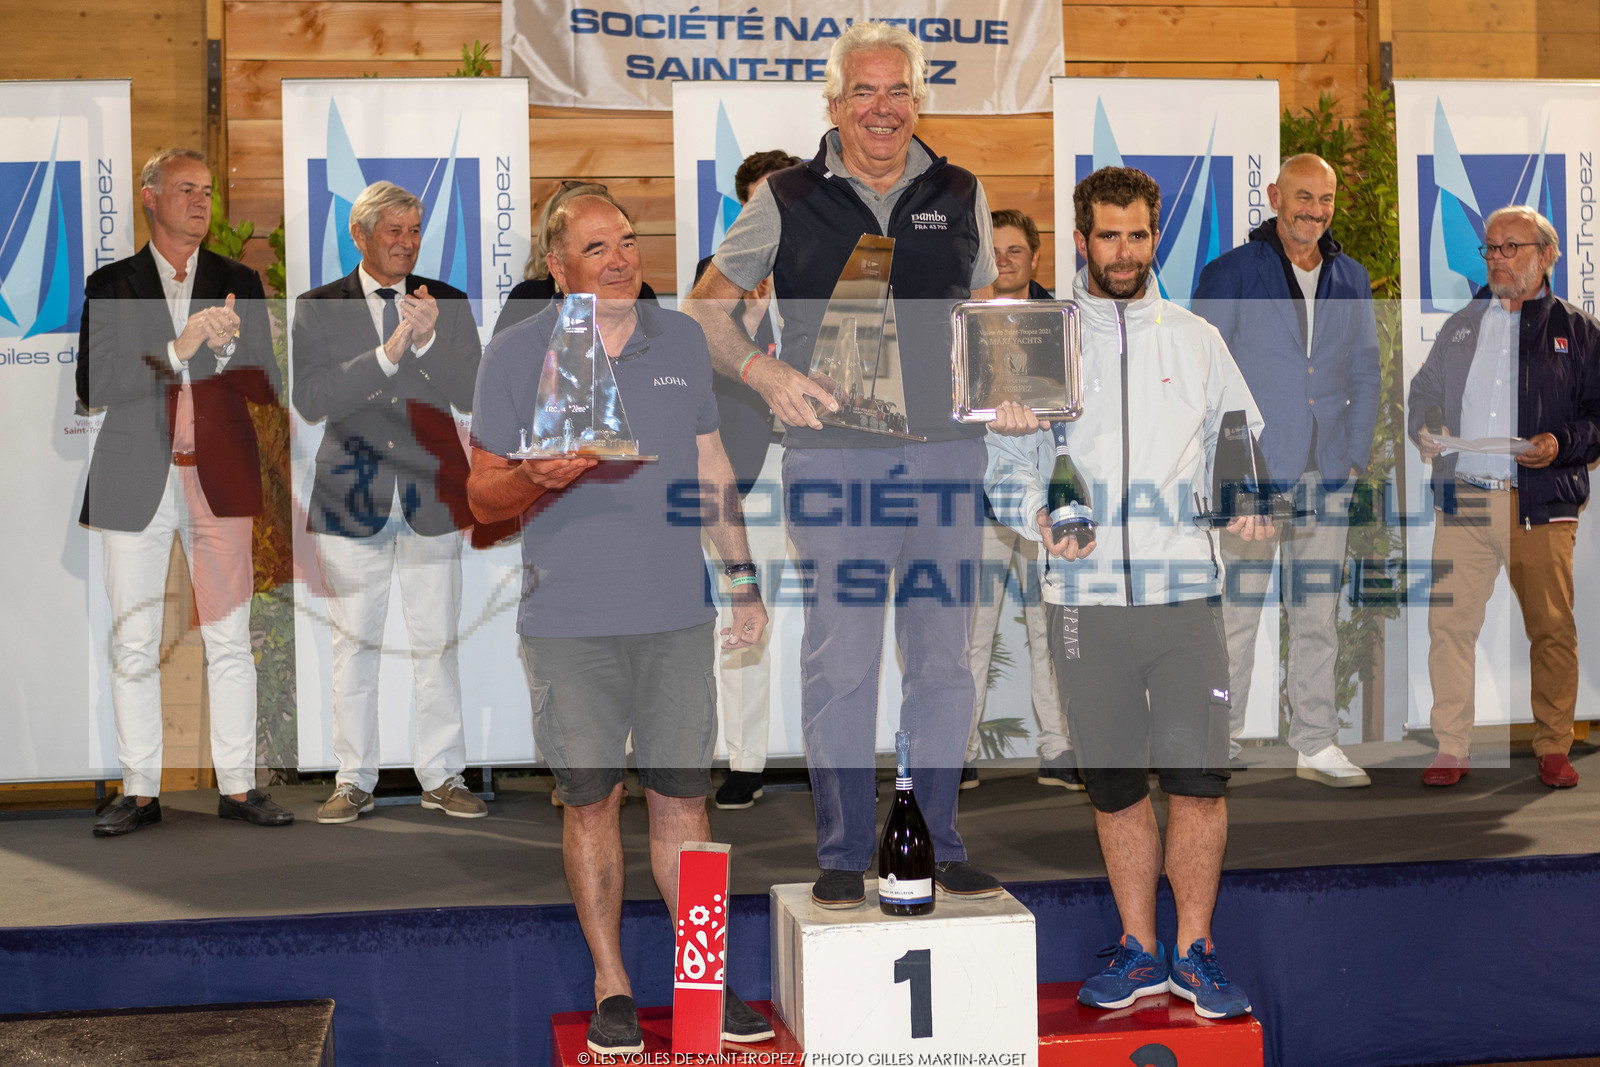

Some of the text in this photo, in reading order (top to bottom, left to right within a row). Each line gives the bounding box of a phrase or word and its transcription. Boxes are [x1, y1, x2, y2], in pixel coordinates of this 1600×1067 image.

[570, 6, 1009, 45] SOCIÉTÉ NAIQUE
[1244, 154, 1265, 245] opez
[1012, 337, 1043, 345] YACHTS
[653, 376, 688, 387] ALOHA
[75, 419, 92, 427] Ville
[894, 949, 933, 1039] 1
